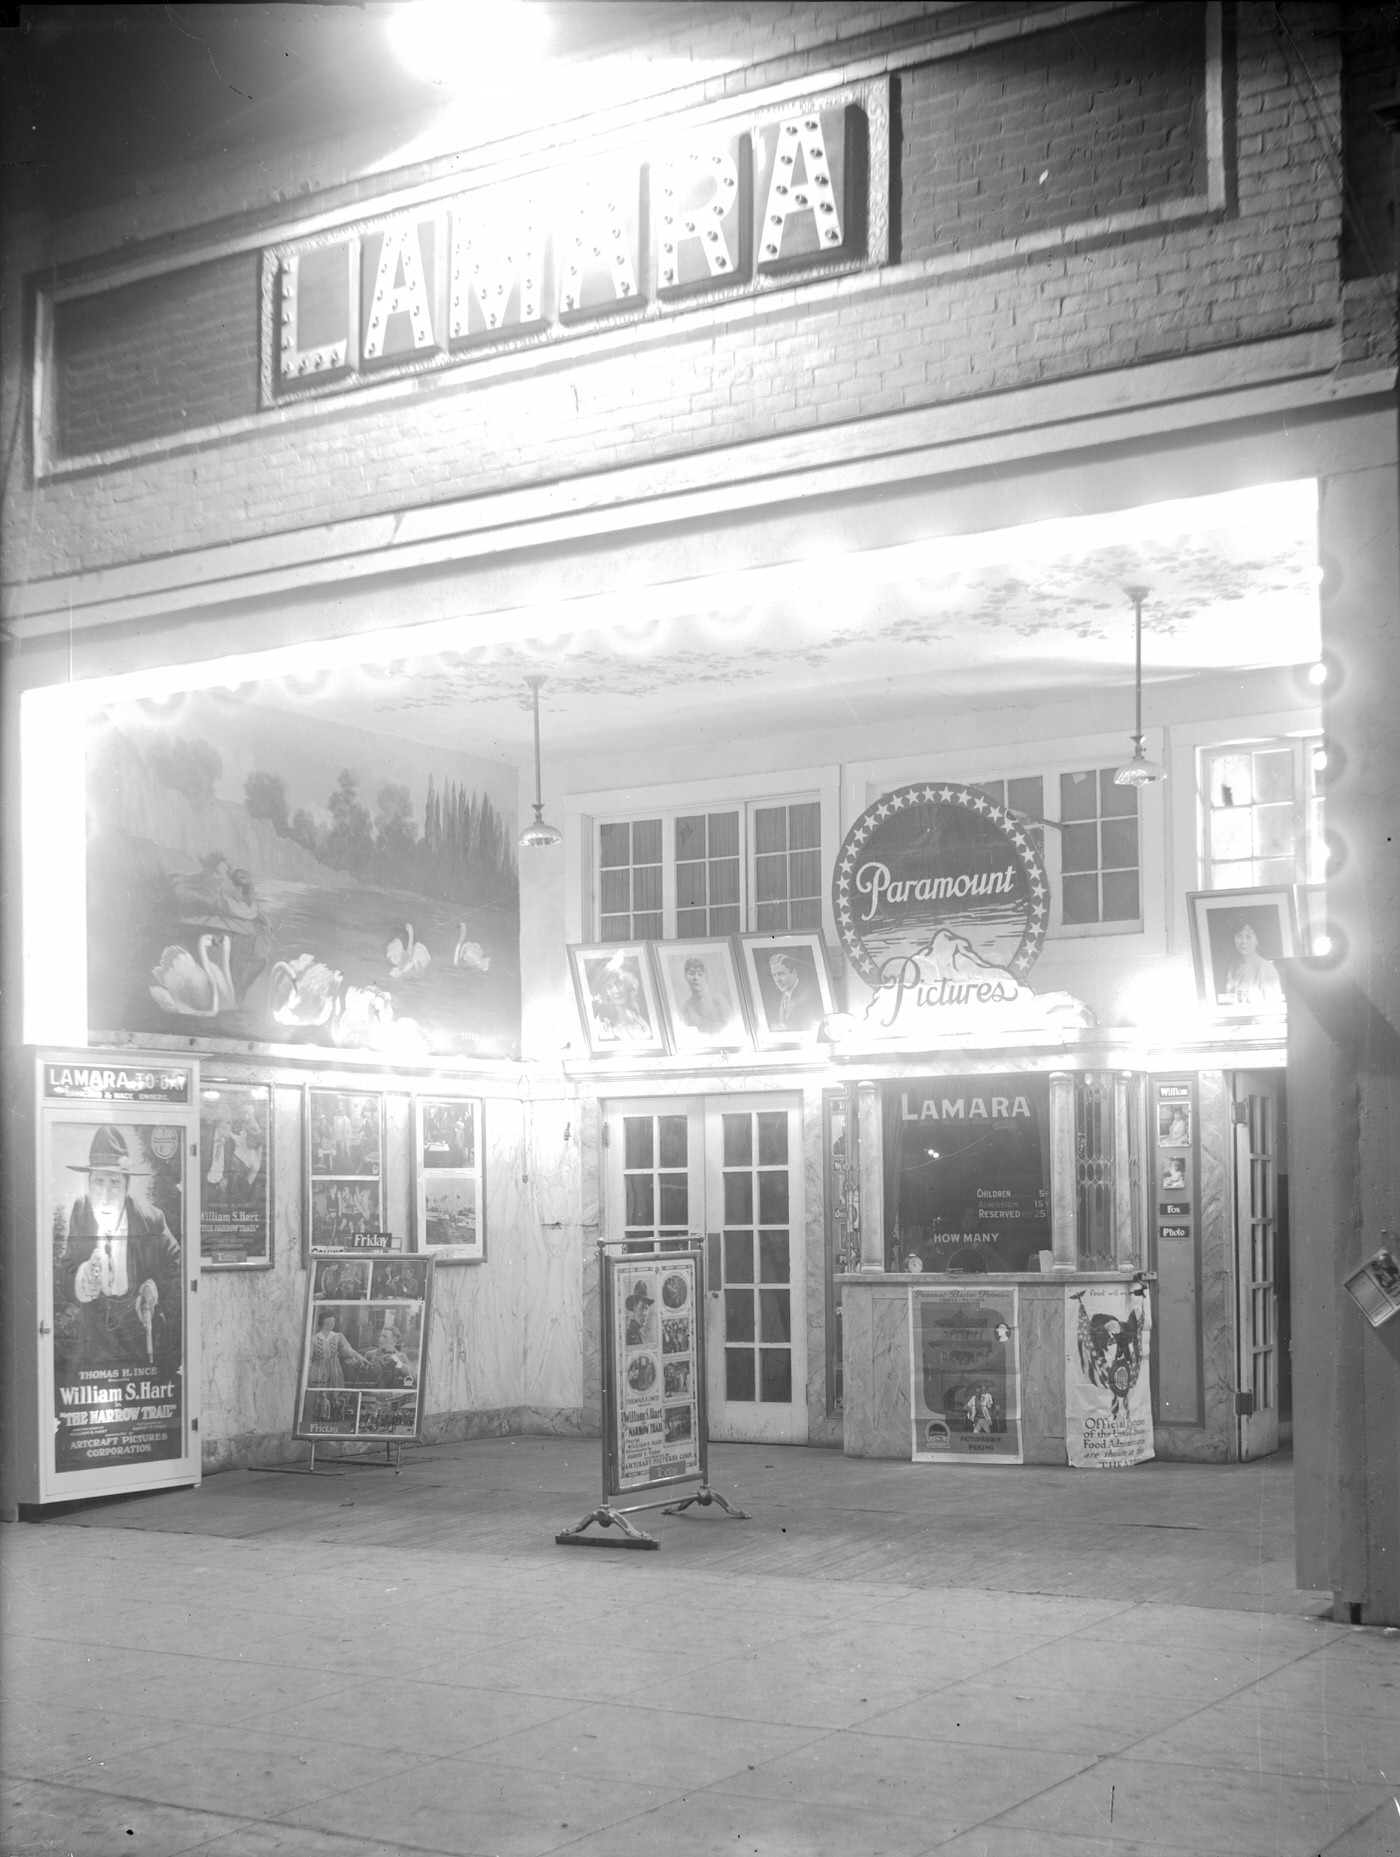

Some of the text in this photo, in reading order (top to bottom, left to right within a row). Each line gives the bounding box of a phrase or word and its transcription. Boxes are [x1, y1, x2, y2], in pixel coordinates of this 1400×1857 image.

[281, 113, 844, 379] LAMARA
[856, 862, 1016, 921] Paramount
[879, 956, 1018, 1027] Pictures
[50, 1068, 129, 1090] LAMARA
[901, 1092, 1032, 1121] LAMARA
[976, 1188, 1011, 1199] CHILDREN
[978, 1208, 1021, 1218] RESERVED
[1167, 1204, 1181, 1214] Fox
[354, 1233, 389, 1248] Friday
[933, 1232, 1000, 1244] HOW MANY
[78, 1369, 120, 1380] THOMAS
[122, 1368, 133, 1377] H.
[134, 1367, 158, 1376] INCE
[59, 1385, 123, 1405] William
[89, 1407, 141, 1424] NARROW
[1085, 1417, 1125, 1429] Official
[1083, 1429, 1096, 1438] of
[1097, 1429, 1111, 1438] the
[70, 1437, 119, 1450] ARTCRAFT
[122, 1432, 168, 1445] PICTURES
[1083, 1438, 1106, 1449] Food
[87, 1444, 152, 1458] CORPORATION
